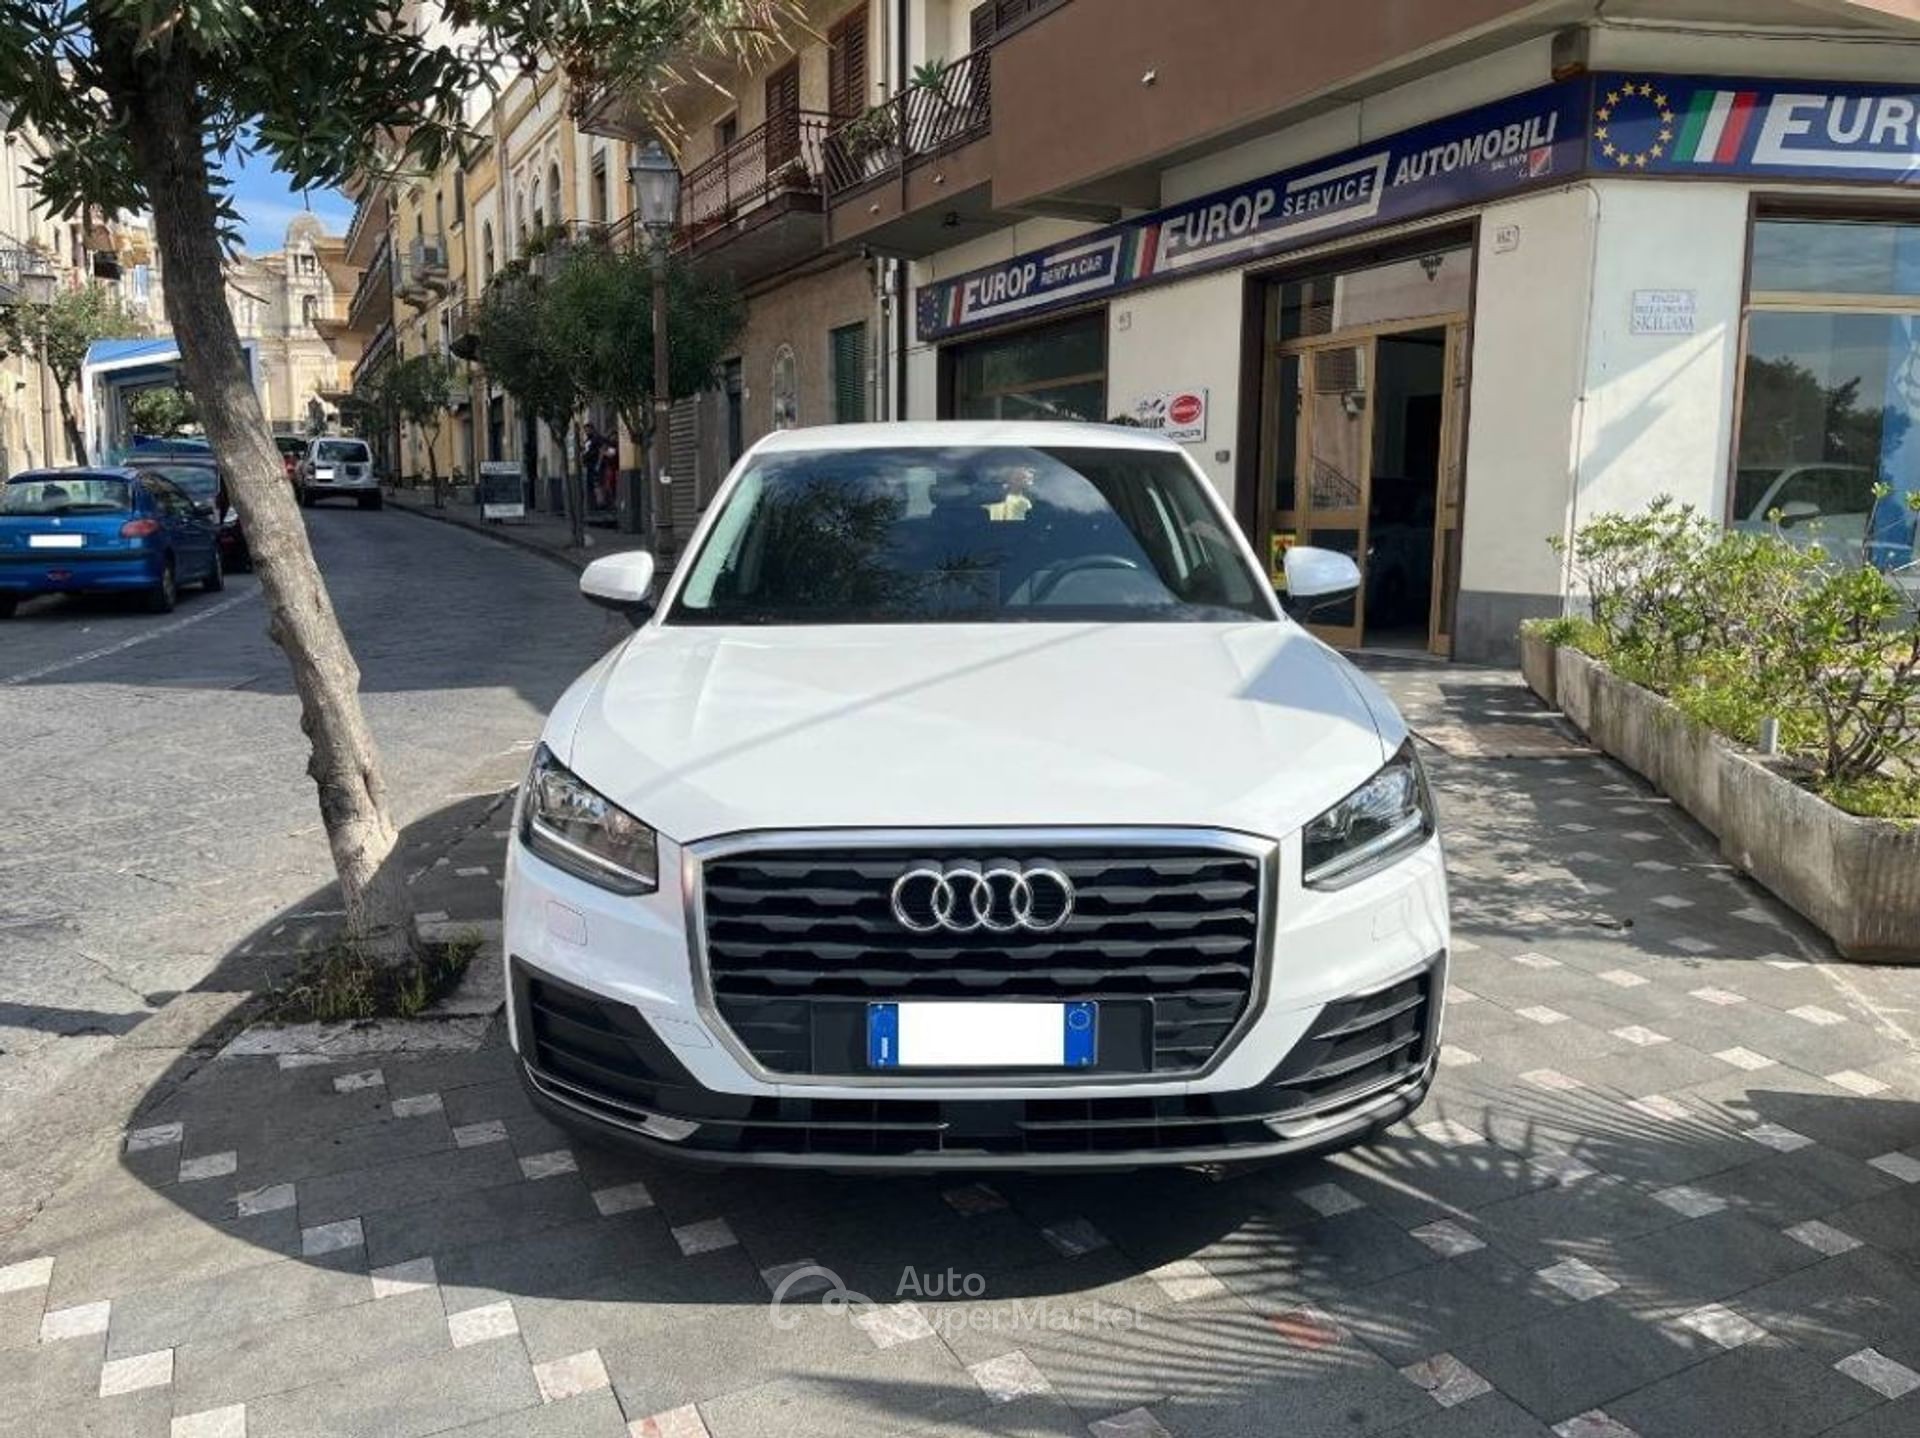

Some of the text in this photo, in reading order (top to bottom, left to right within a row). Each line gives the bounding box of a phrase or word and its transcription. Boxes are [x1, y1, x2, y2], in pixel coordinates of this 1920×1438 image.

[1392, 110, 1559, 187] AUTOMOBILI
[1751, 93, 1920, 165] EUR
[1153, 174, 1372, 273] EUROP SERVICE
[960, 254, 1103, 324] EUROP RENT A CAR
